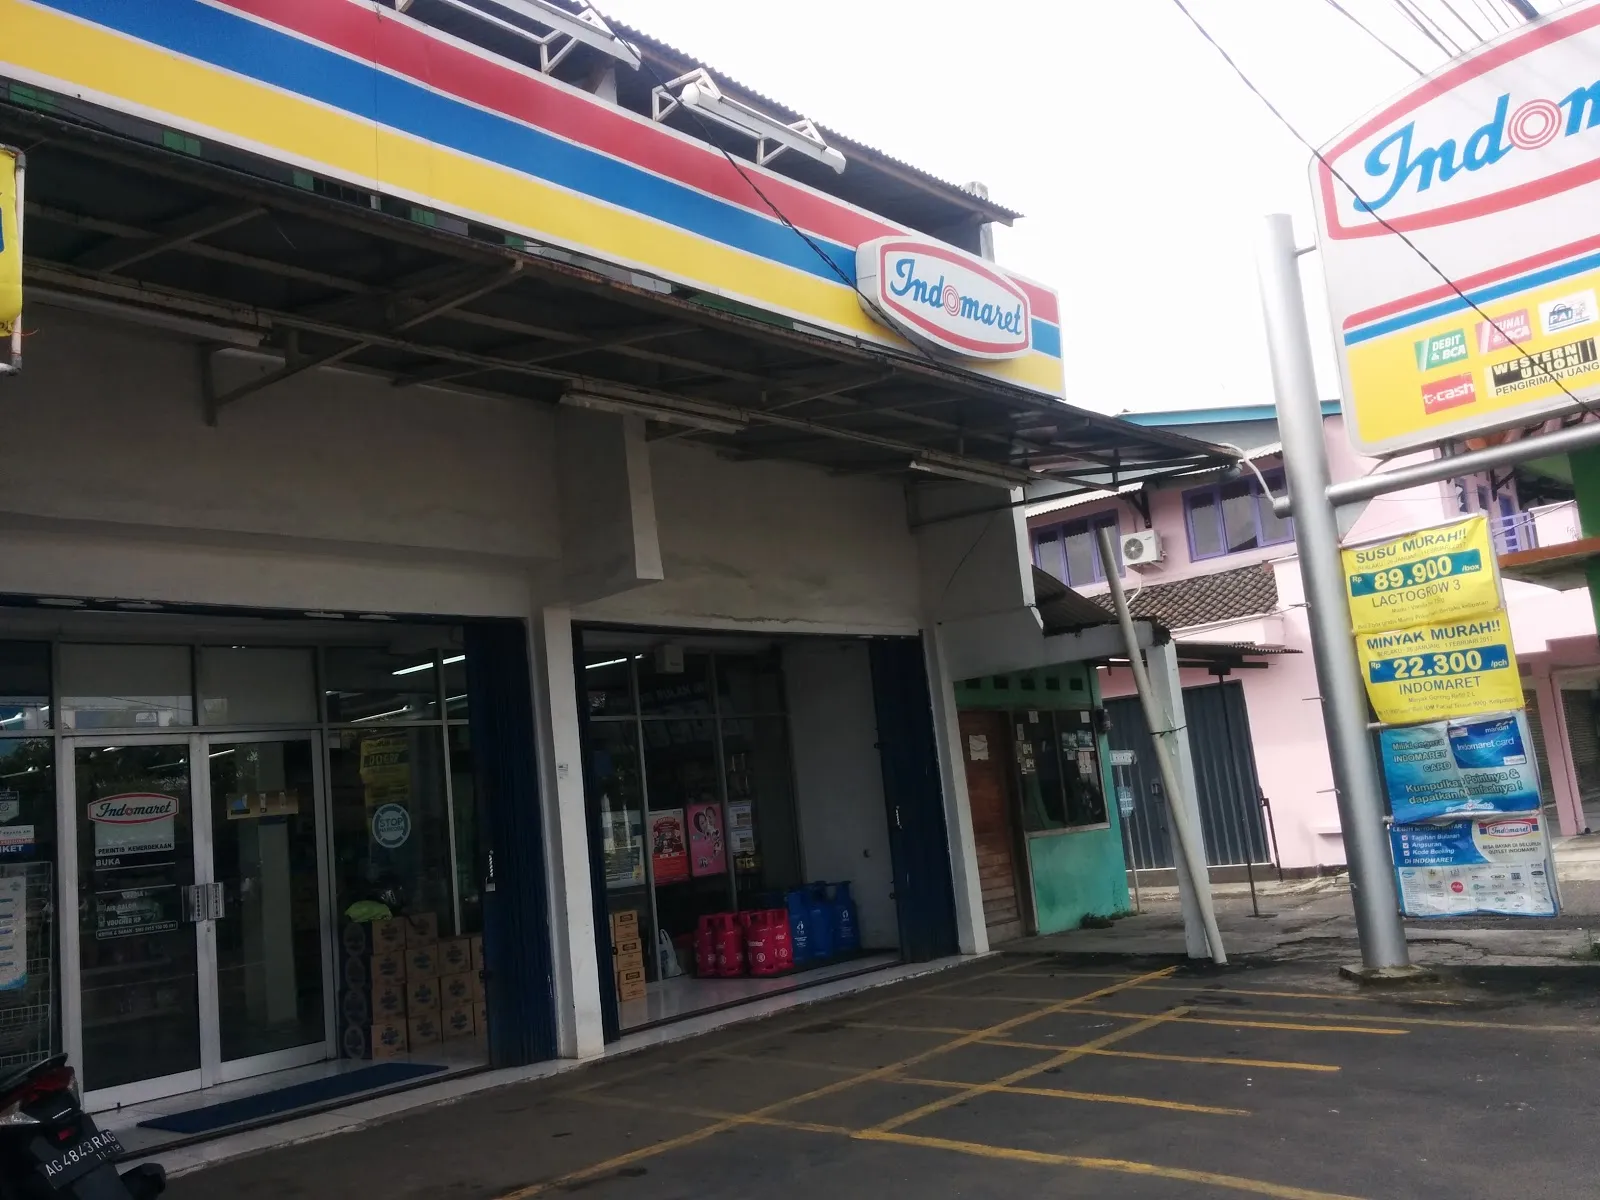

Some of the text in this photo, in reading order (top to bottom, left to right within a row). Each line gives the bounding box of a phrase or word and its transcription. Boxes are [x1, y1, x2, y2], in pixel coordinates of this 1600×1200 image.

[889, 258, 1022, 336] Indomaret
[1432, 334, 1461, 352] DEBIT
[1431, 344, 1467, 362] & BCA
[1493, 343, 1578, 375] WESTERN
[1520, 352, 1580, 383] UNION
[1495, 360, 1600, 397] PENGIRIMAN UANG
[1356, 527, 1467, 564] SUSU MURAH!!
[1374, 555, 1453, 591] 89.900
[1462, 564, 1480, 573] /box
[1371, 579, 1461, 608] LACTOGROW 3
[1366, 619, 1501, 650] MINYAK MURAH!!
[1371, 650, 1508, 679] Rp 22.300 /pch
[1399, 676, 1482, 695] INDOMARET
[1456, 737, 1515, 751] Indomaret card
[1393, 749, 1448, 763] INDOMARET
[1422, 761, 1452, 773] CARD
[1464, 770, 1508, 785] Pointnya
[1508, 768, 1521, 779] &
[1409, 788, 1458, 805] dapatkan
[96, 800, 172, 818] Indomaret
[380, 817, 403, 828] STOP
[1491, 826, 1529, 835] Indomaret
[1411, 834, 1436, 842] Tagihan
[1411, 842, 1442, 850] Angsuran
[98, 842, 172, 855] PERINTIS KEMERDEKAAN
[1430, 847, 1455, 856] Booking
[96, 857, 121, 867] BUKA
[1412, 856, 1454, 865] INDOMARET
[106, 917, 133, 927] VOUCHER
[45, 1158, 64, 1177] AG
[63, 1140, 95, 1167] 4843
